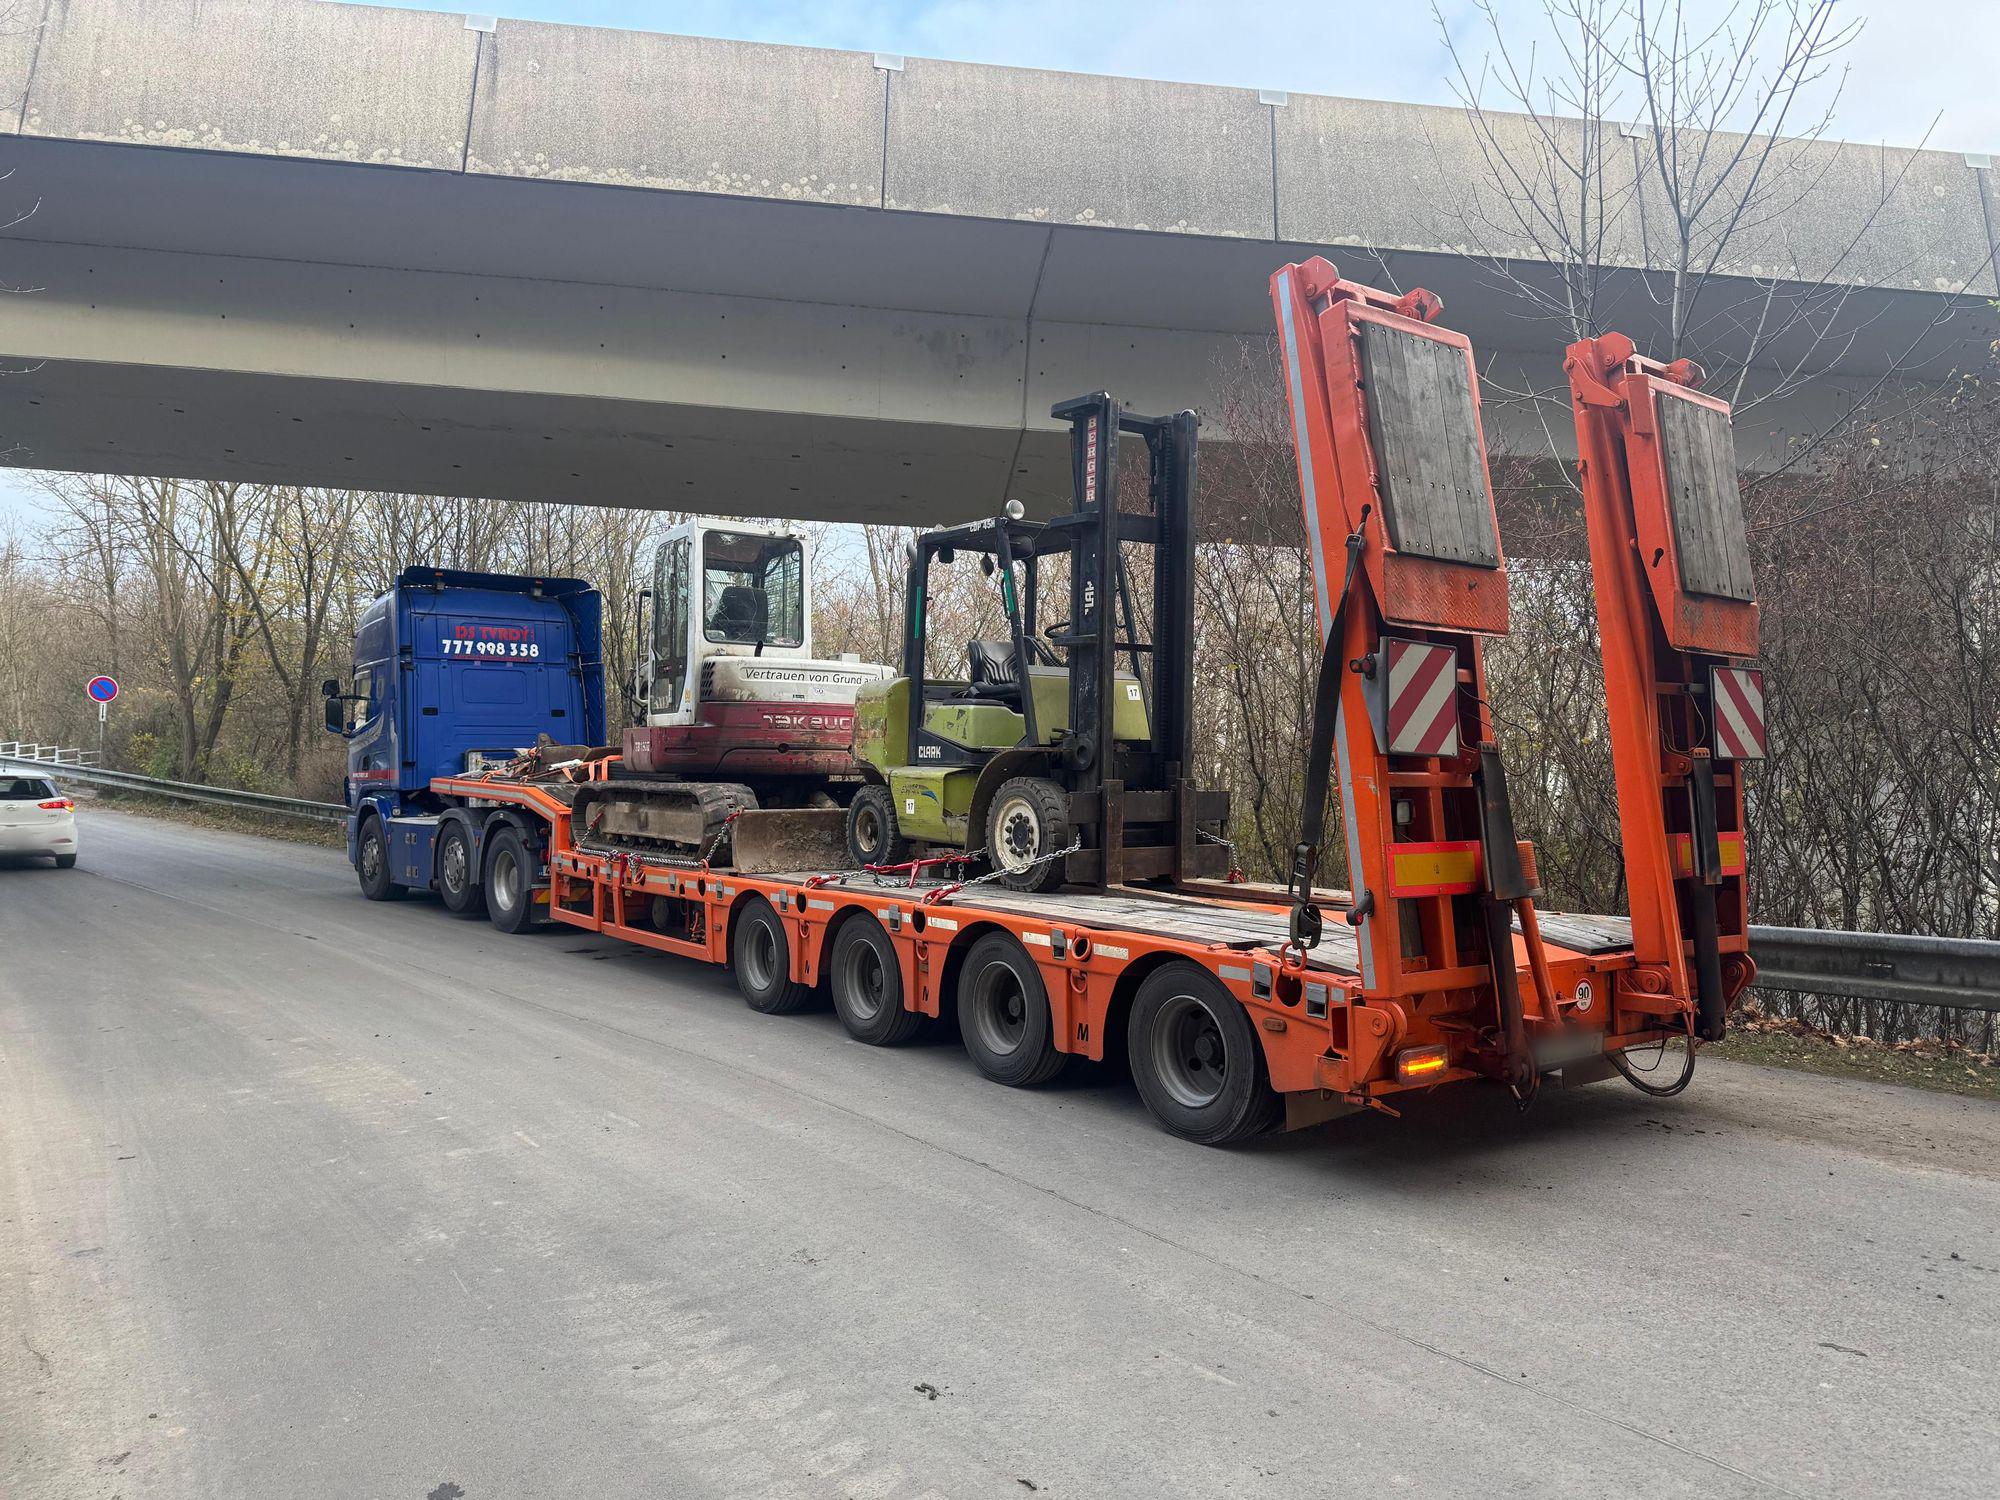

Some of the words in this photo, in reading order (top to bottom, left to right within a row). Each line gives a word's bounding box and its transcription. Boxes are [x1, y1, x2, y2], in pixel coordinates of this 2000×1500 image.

[1086, 417, 1097, 502] BERGER
[442, 639, 474, 655] 777
[476, 641, 506, 656] 998
[510, 643, 539, 658] 358
[745, 668, 805, 681] Vertrauen
[809, 674, 829, 683] von
[832, 673, 862, 685] Grund
[1130, 688, 1138, 697] 17
[918, 745, 942, 759] CLARK
[907, 802, 914, 811] 17
[1578, 986, 1590, 1000] 90
[1077, 1022, 1089, 1042] M
